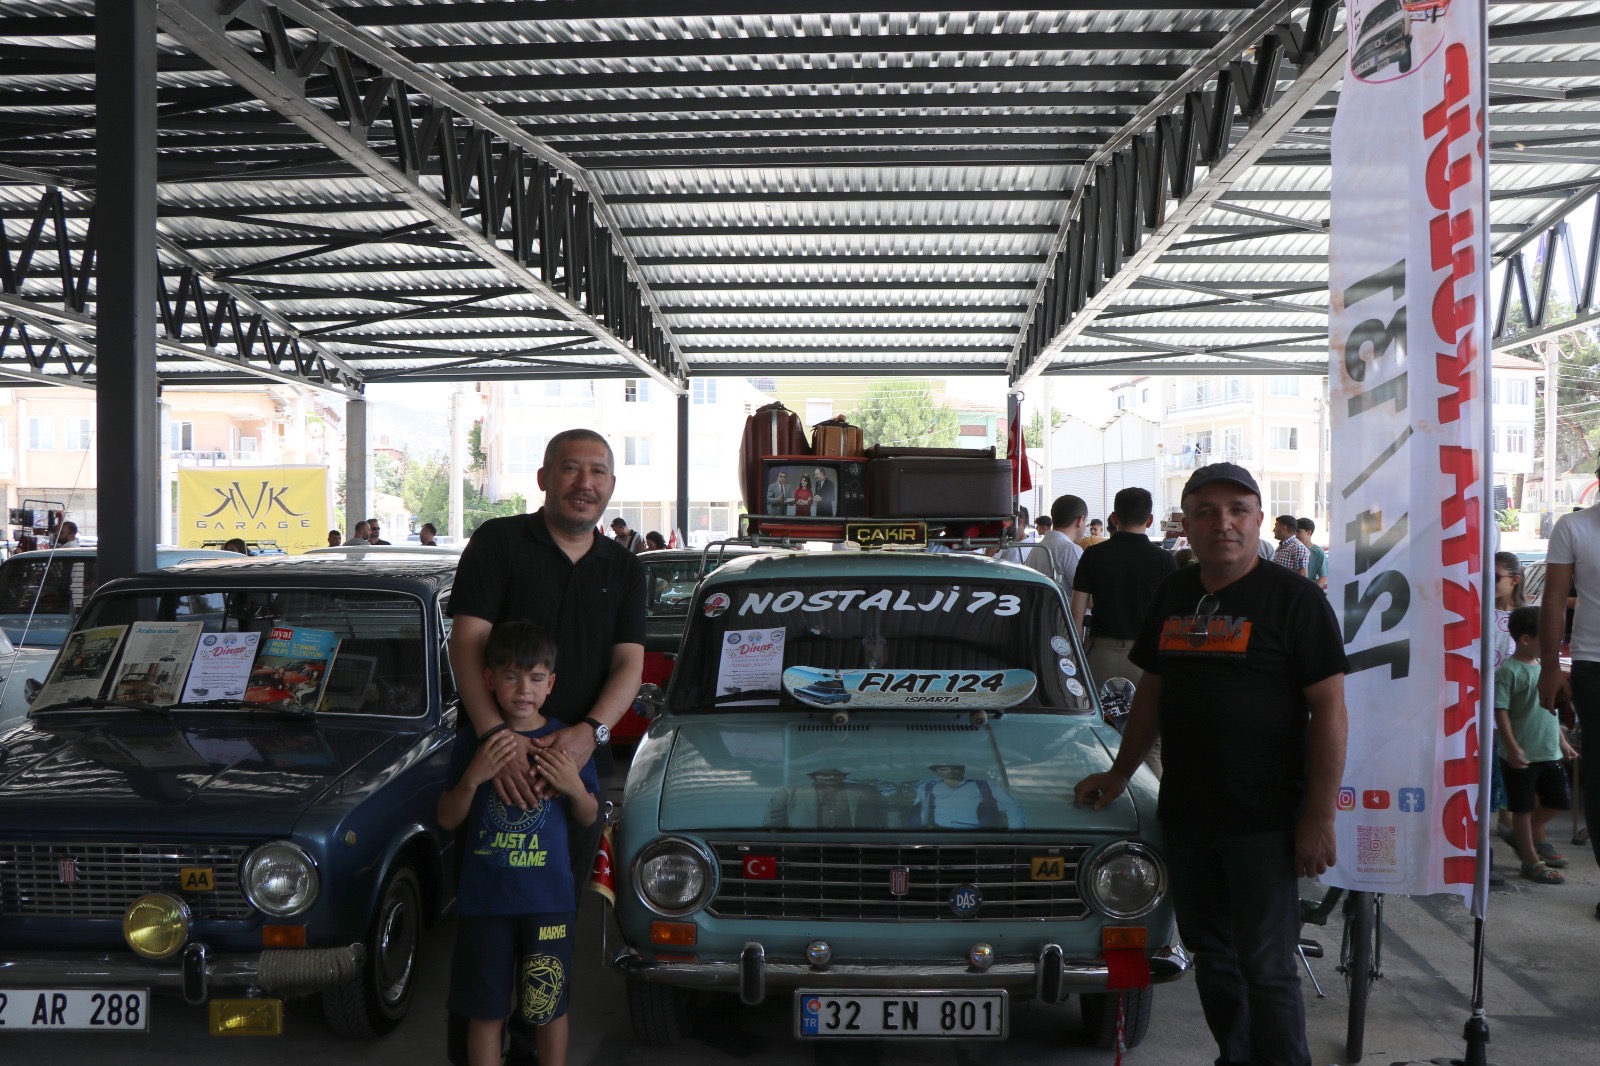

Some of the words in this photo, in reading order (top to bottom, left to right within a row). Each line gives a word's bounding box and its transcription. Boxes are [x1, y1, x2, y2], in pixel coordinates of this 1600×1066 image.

[196, 519, 311, 530] GARAGE
[857, 528, 917, 546] ÇAKIR
[966, 591, 1021, 616] 73
[269, 629, 292, 640] ayat
[213, 645, 247, 657] Dinar
[739, 642, 774, 655] Dinar
[857, 672, 940, 694] FIAT
[946, 672, 1004, 694] 124
[904, 695, 960, 706] ISPARTA
[490, 832, 527, 849] JUST
[528, 834, 539, 850] A
[508, 850, 548, 867] GAME
[60, 860, 75, 883] FIAT
[1035, 860, 1060, 877] AA
[185, 870, 209, 888] AA
[892, 871, 906, 893] FIAT
[956, 891, 976, 909] DAS
[538, 924, 567, 941] MARVEL
[31, 993, 66, 1026] AR
[89, 993, 141, 1026] 288
[825, 1000, 861, 1030] 32
[882, 1000, 919, 1030] EN
[940, 1000, 993, 1030] 801
[803, 1018, 817, 1027] TR
